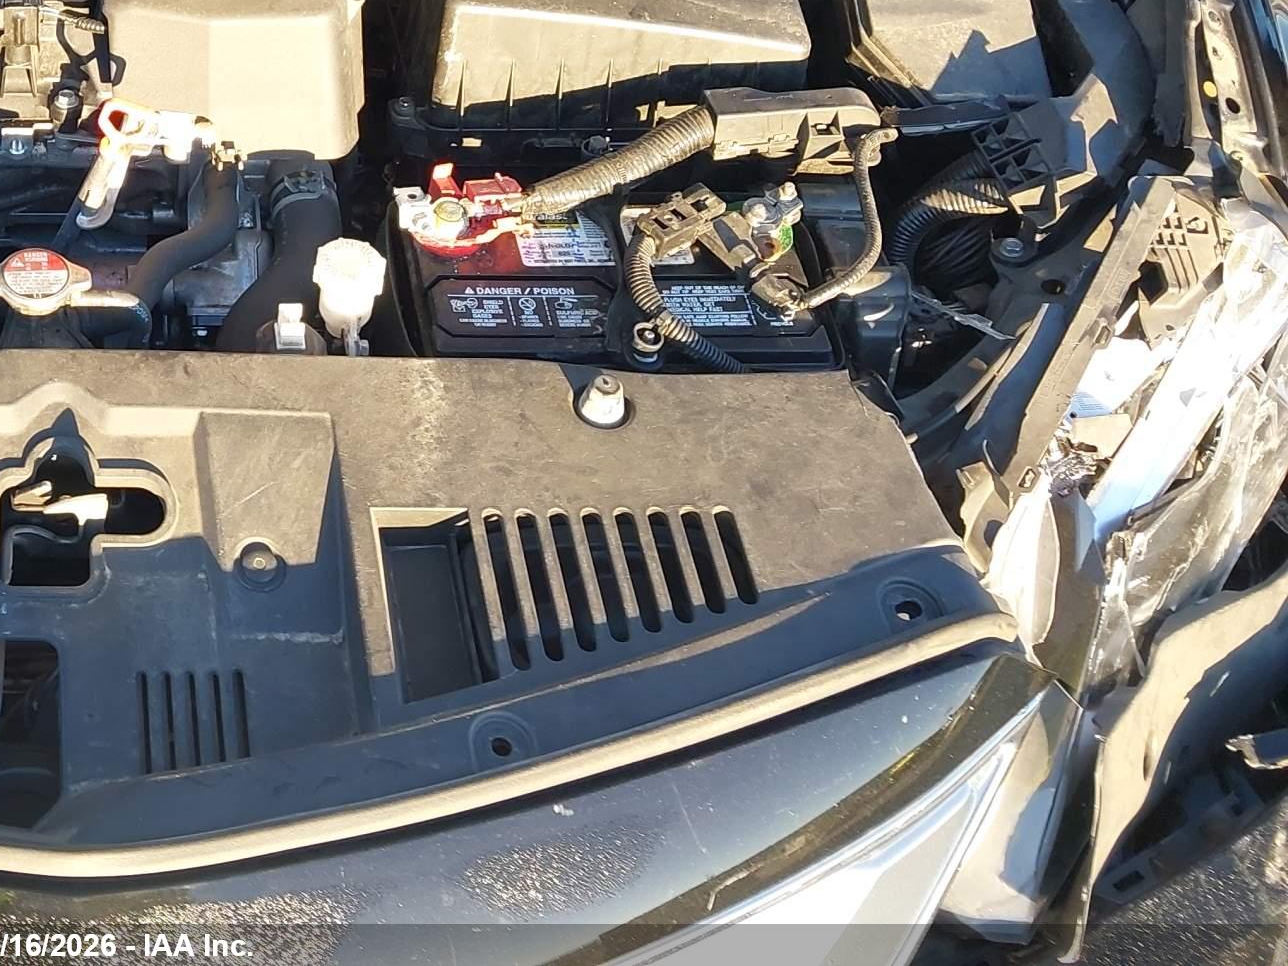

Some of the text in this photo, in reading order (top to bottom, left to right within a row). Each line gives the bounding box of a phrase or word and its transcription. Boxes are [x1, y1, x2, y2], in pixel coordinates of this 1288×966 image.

[476, 287, 575, 295] DANGER / POISON
